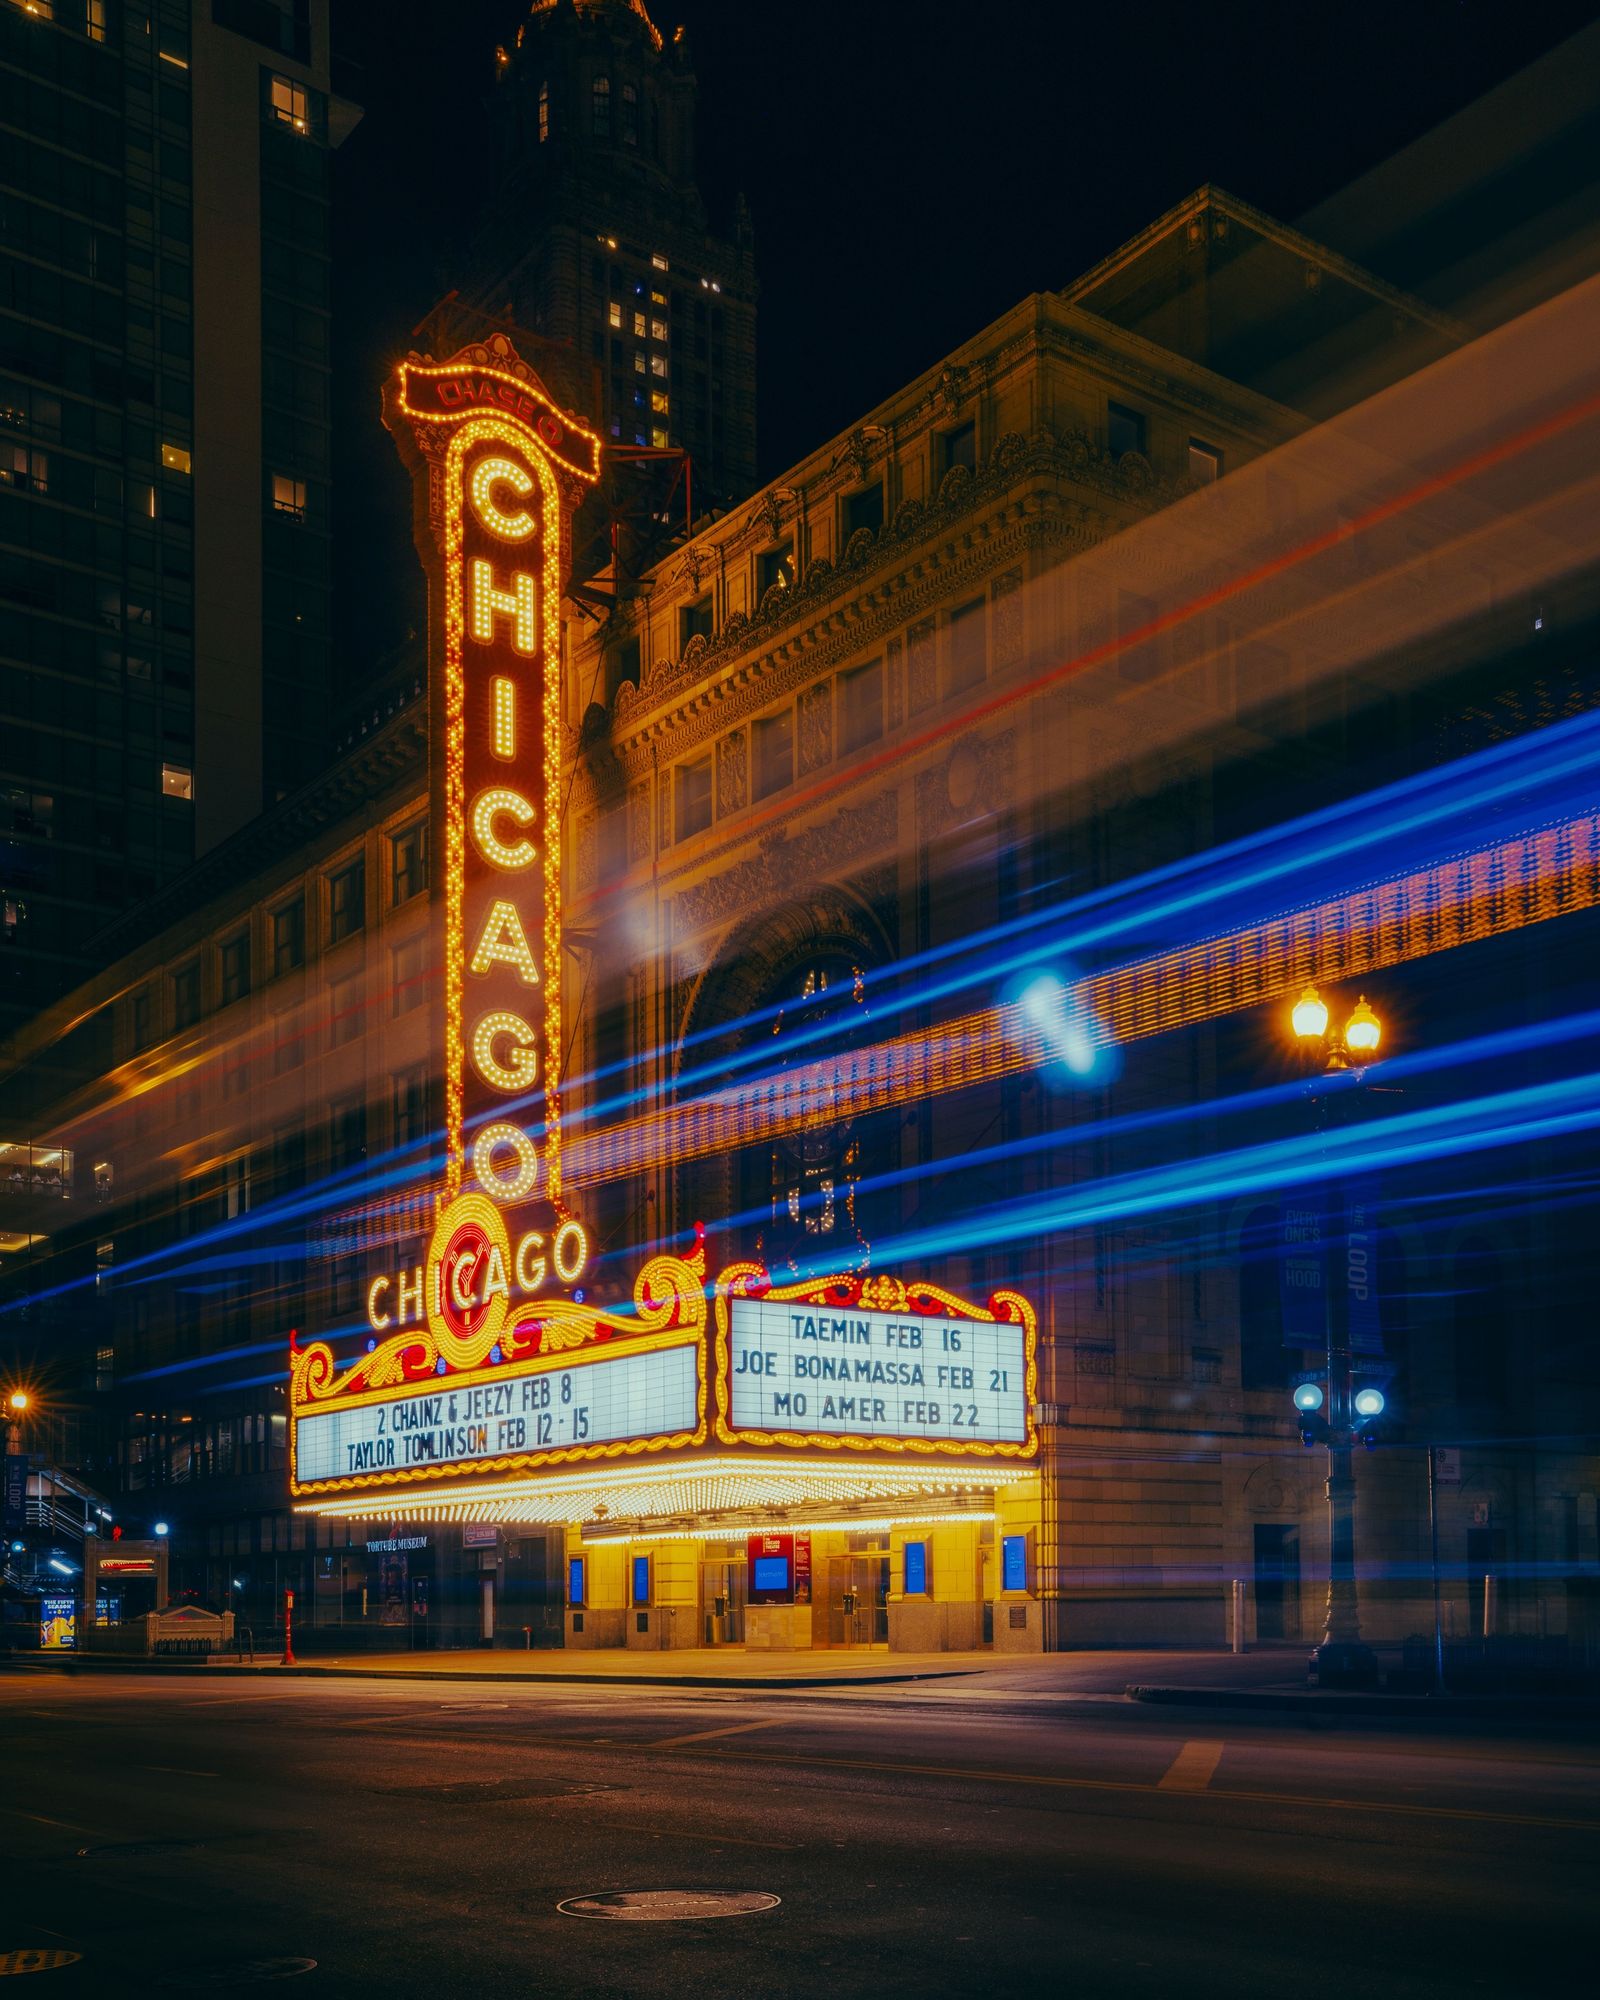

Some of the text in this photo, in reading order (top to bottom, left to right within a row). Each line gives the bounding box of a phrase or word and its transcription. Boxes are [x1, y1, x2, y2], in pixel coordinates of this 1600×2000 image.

[436, 378, 536, 424] CHASE
[471, 457, 538, 1200] CHICAGO
[1284, 1226, 1321, 1244] ONE'S
[1285, 1209, 1321, 1226] EVERY
[368, 1219, 588, 1330] CHICAGO
[1285, 1270, 1321, 1288] HOOD
[1347, 1233, 1369, 1301] LOOP
[791, 1314, 962, 1352] TAEMIN FEB 16
[735, 1349, 1009, 1392] JOE BONAMASSA FEB 21
[377, 1373, 572, 1436] 2 CHAINZ & JEEZY FEB 8
[773, 1391, 980, 1427] MO AMER FEB 22
[347, 1438, 395, 1472] TAYLOR
[402, 1423, 488, 1462] TOMLINSON
[498, 1417, 526, 1450] FEB
[537, 1412, 552, 1445] 12
[573, 1406, 589, 1440] 15
[9, 1483, 22, 1510] LOOP
[366, 1536, 427, 1552] TORTURE MUSEUM
